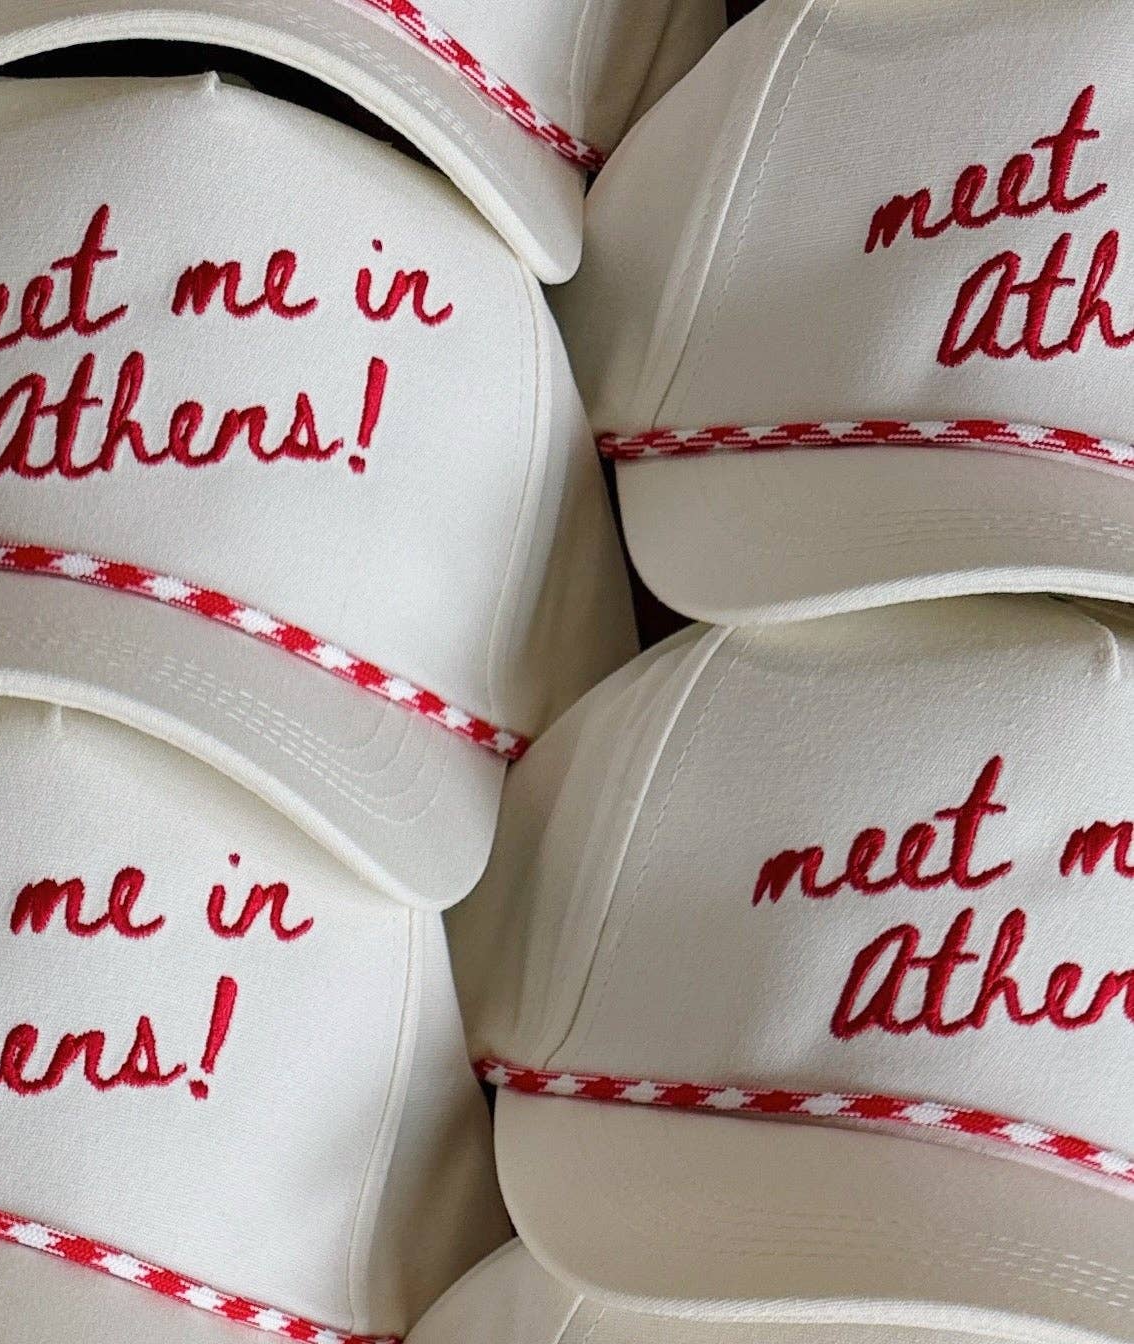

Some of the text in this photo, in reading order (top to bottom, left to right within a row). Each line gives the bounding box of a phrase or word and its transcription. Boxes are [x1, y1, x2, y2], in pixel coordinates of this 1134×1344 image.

[870, 85, 1107, 247] meet
[172, 250, 317, 319] me
[356, 240, 453, 325] in
[753, 756, 1011, 902] meet
[10, 867, 165, 938] me
[207, 854, 313, 941] in
